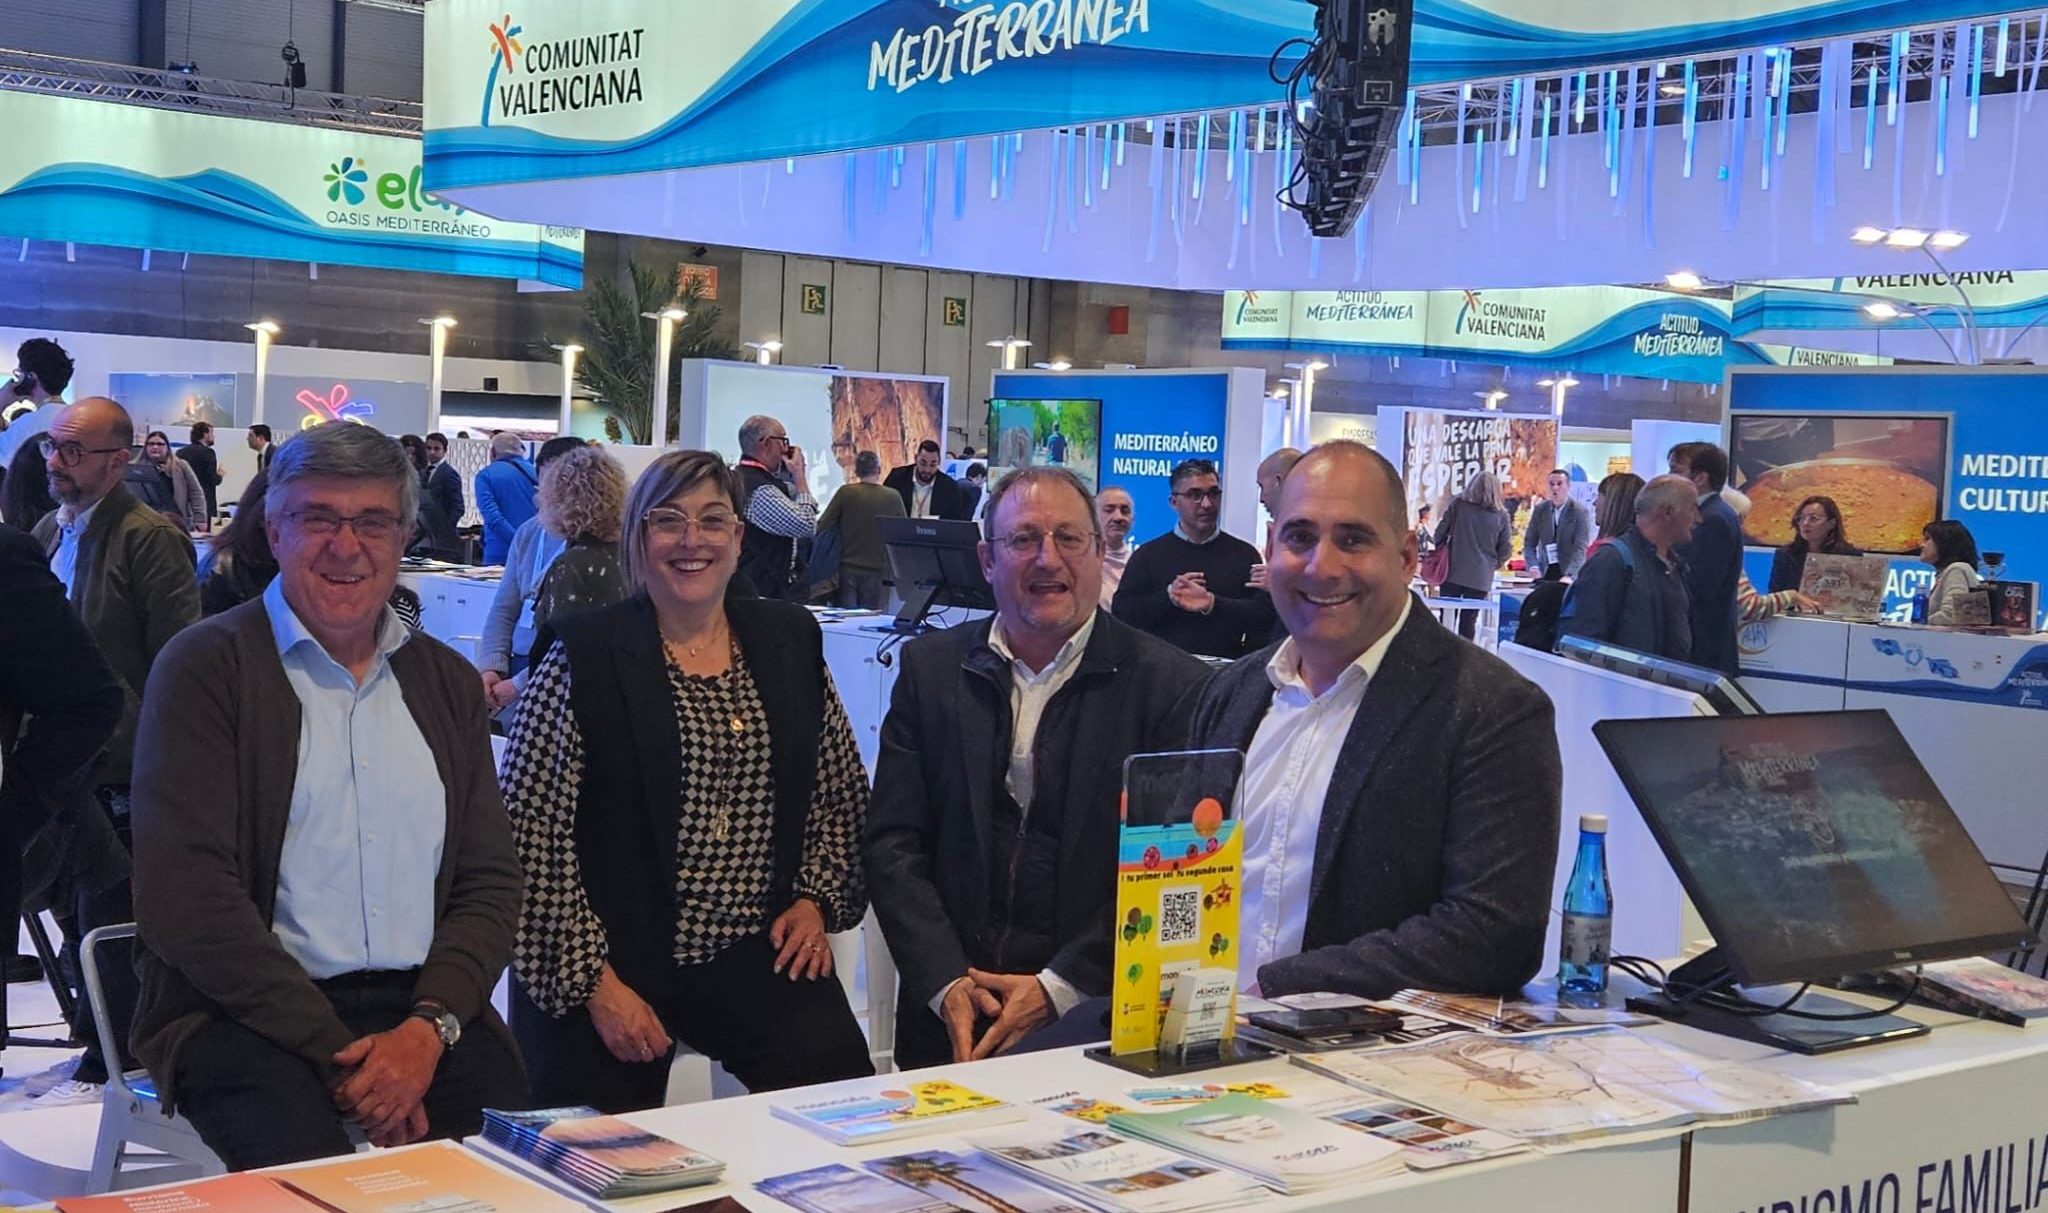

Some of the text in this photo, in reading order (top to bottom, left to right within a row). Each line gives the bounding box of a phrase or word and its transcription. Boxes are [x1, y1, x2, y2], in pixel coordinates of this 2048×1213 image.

[525, 29, 644, 74] COMUNITAT
[500, 67, 642, 117] VALENCIANA
[327, 210, 491, 238] OASIS MEDITERRÁNEO
[1336, 291, 1382, 304] ACTITUD
[1306, 301, 1413, 321] MEDITERRÁNEA
[1483, 302, 1547, 322] COMUNITAT
[1467, 318, 1545, 341] VALENCIANA
[1660, 313, 1699, 333] ACTITUD
[1634, 330, 1723, 357] MEDITERRÁNEA
[1114, 431, 1218, 453] MEDITERRÁNEO
[1408, 424, 1438, 447] UNA
[1465, 441, 1479, 460] LA
[1113, 457, 1172, 477] NATURAL
